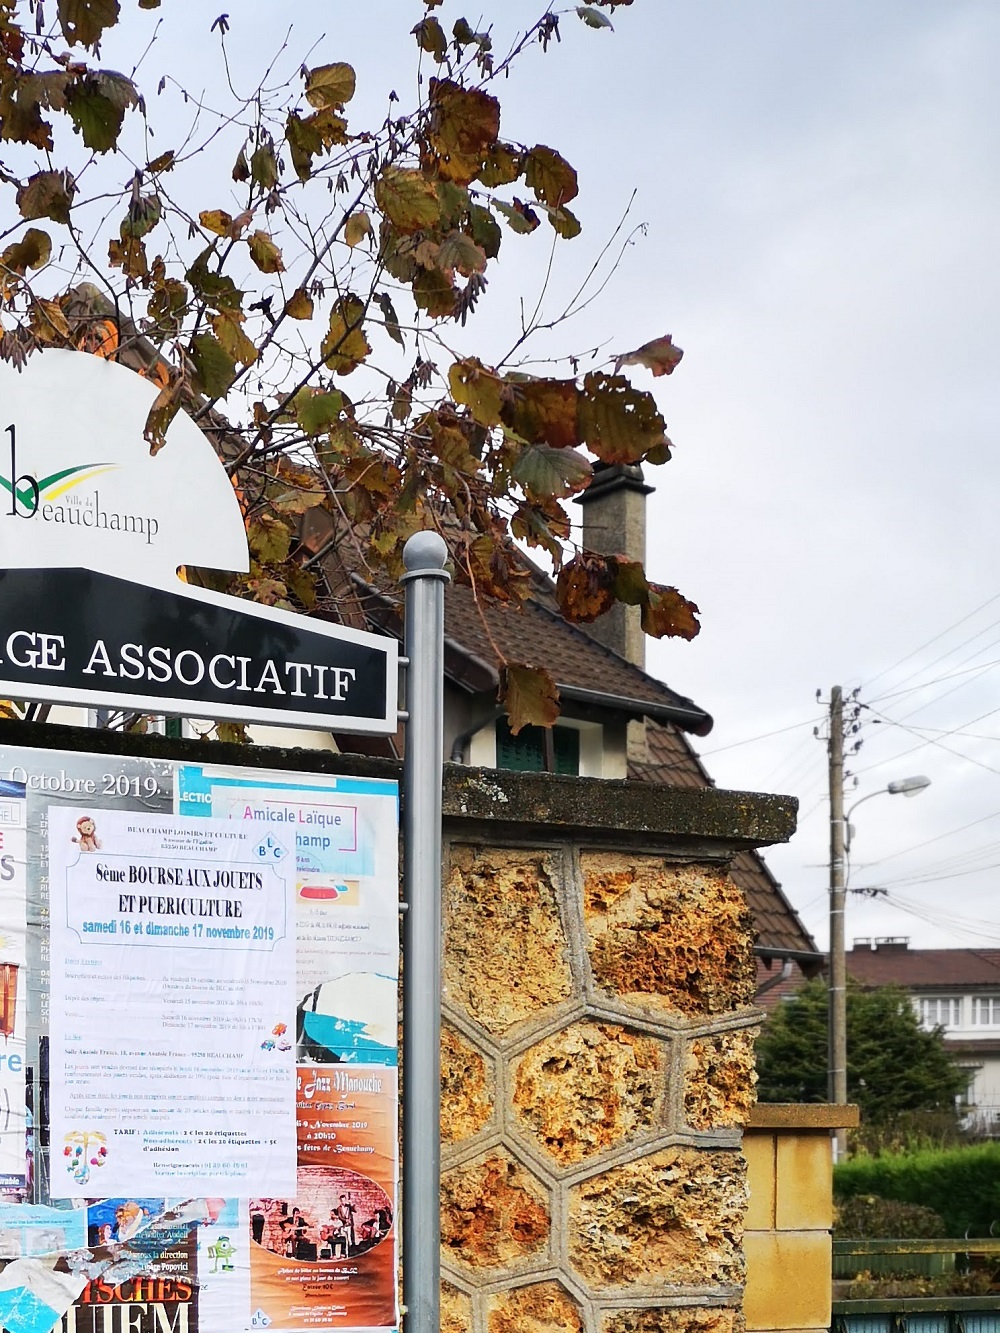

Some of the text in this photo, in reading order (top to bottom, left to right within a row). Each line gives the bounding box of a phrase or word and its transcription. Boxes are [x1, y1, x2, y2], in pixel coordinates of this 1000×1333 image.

[65, 495, 94, 507] Ville de
[83, 638, 357, 702] ASSOCIATIF
[10, 766, 97, 795] Octobre
[244, 806, 342, 829] Amicale Laïque
[96, 863, 263, 891] 8ème BOURSE AUX JOUETS
[119, 894, 243, 918] ET PUERICULTURE
[82, 918, 275, 941] samedi 16 et dimanche 17 novembre 2019
[304, 1070, 331, 1099] Jazz
[333, 1070, 382, 1099] Manouche
[303, 1120, 368, 1129] 9 Novembre 2019
[304, 1143, 321, 1151] fêtes
[323, 1144, 331, 1152] de
